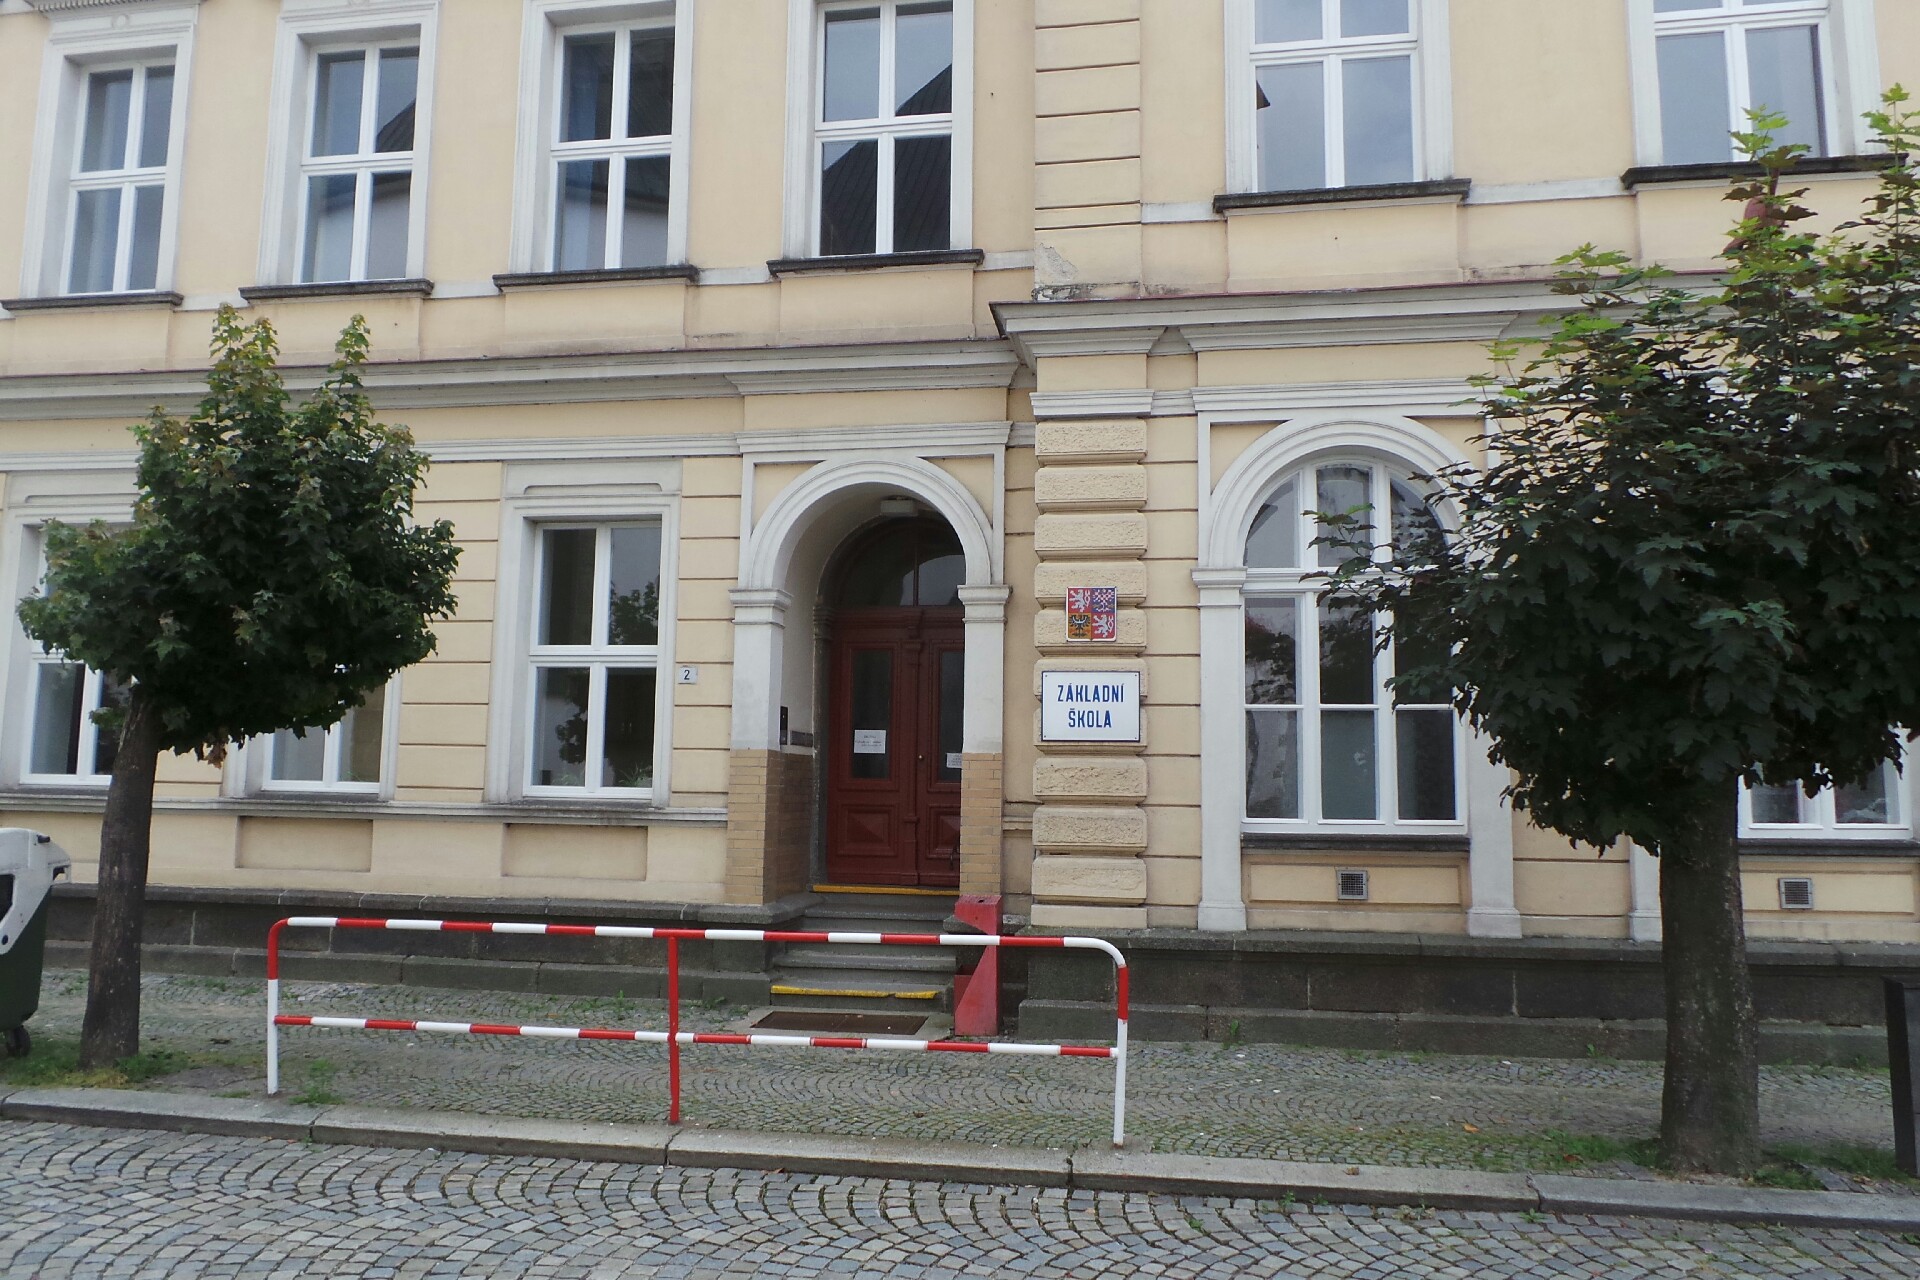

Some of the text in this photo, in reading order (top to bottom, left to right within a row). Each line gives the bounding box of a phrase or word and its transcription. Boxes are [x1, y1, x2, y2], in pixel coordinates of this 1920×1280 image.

[684, 669, 690, 680] 2
[1057, 683, 1125, 703] ZÁKLADNÍ
[1068, 708, 1112, 728] ŠKOLA
